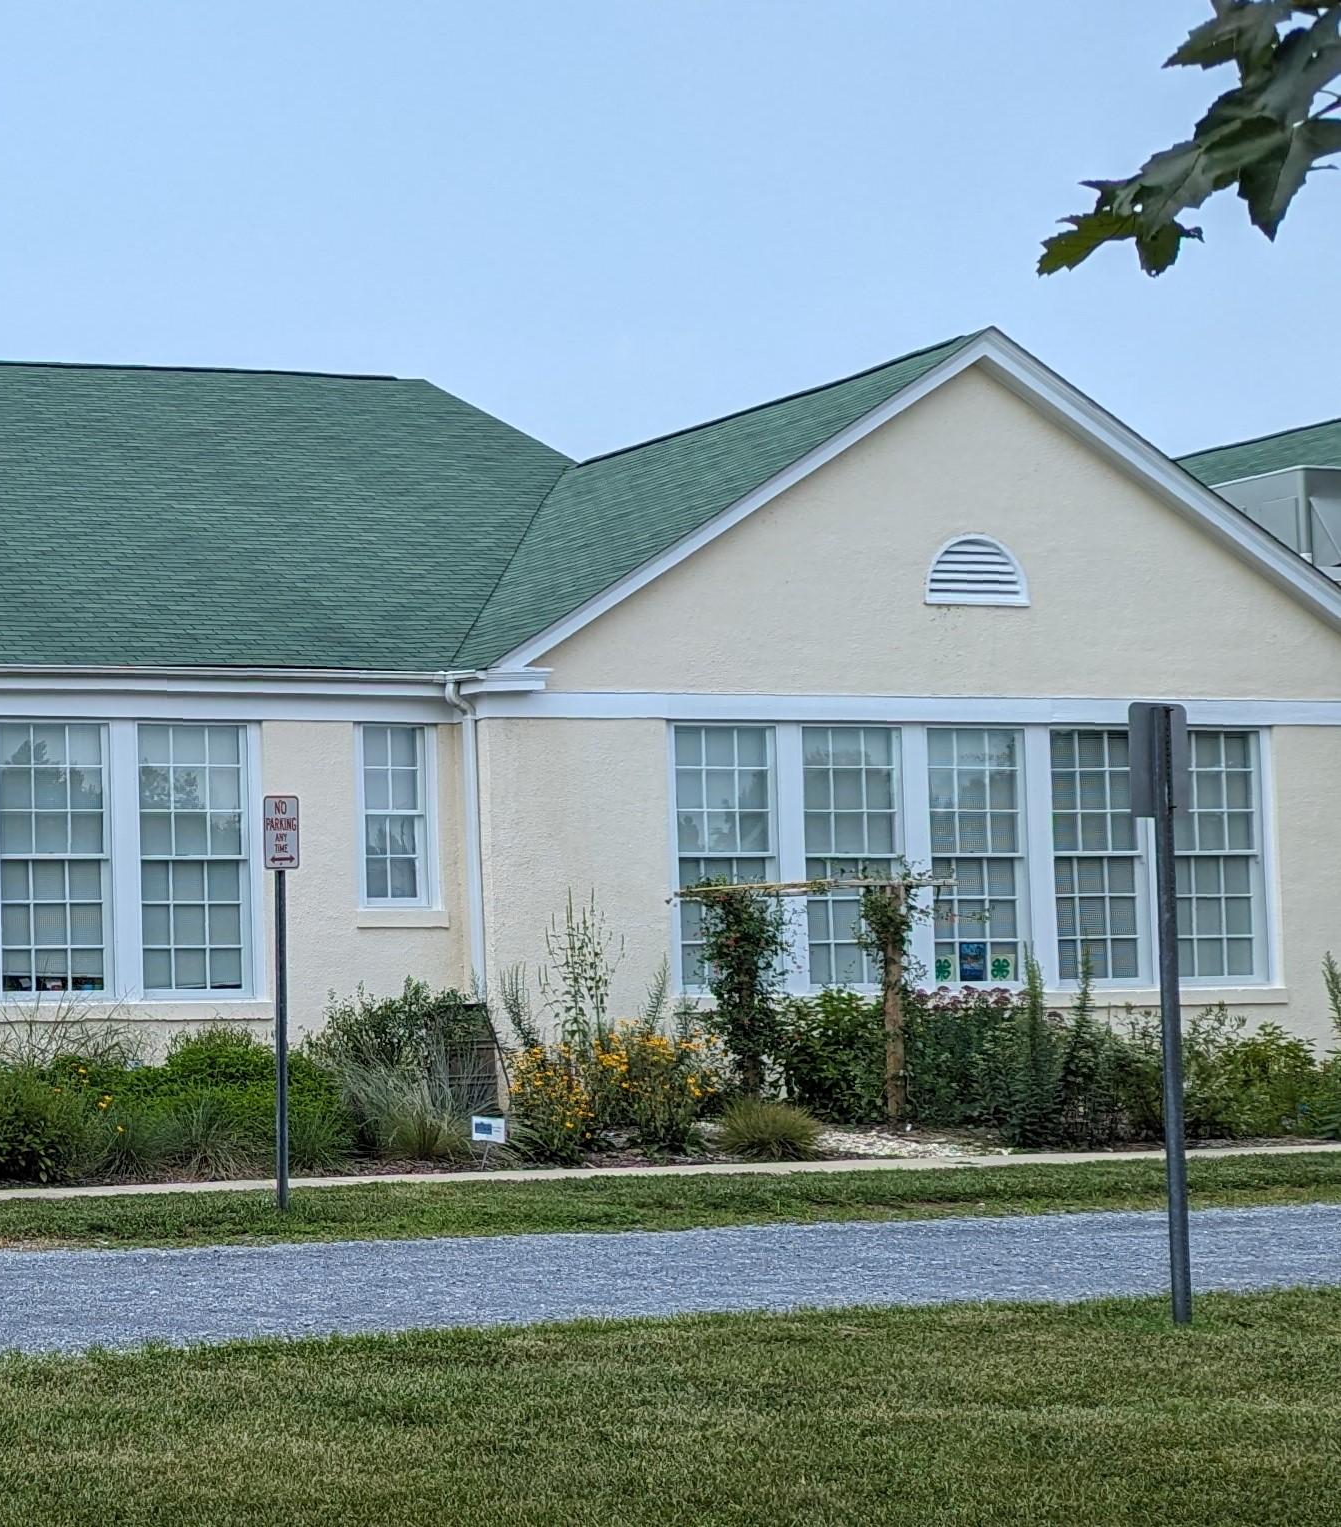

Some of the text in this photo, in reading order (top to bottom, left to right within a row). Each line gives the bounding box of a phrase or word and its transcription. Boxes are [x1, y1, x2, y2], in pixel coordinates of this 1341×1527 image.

[274, 800, 287, 815] NO
[266, 817, 296, 831] PARKING
[275, 833, 287, 842] ANY
[274, 844, 288, 853] TIME
